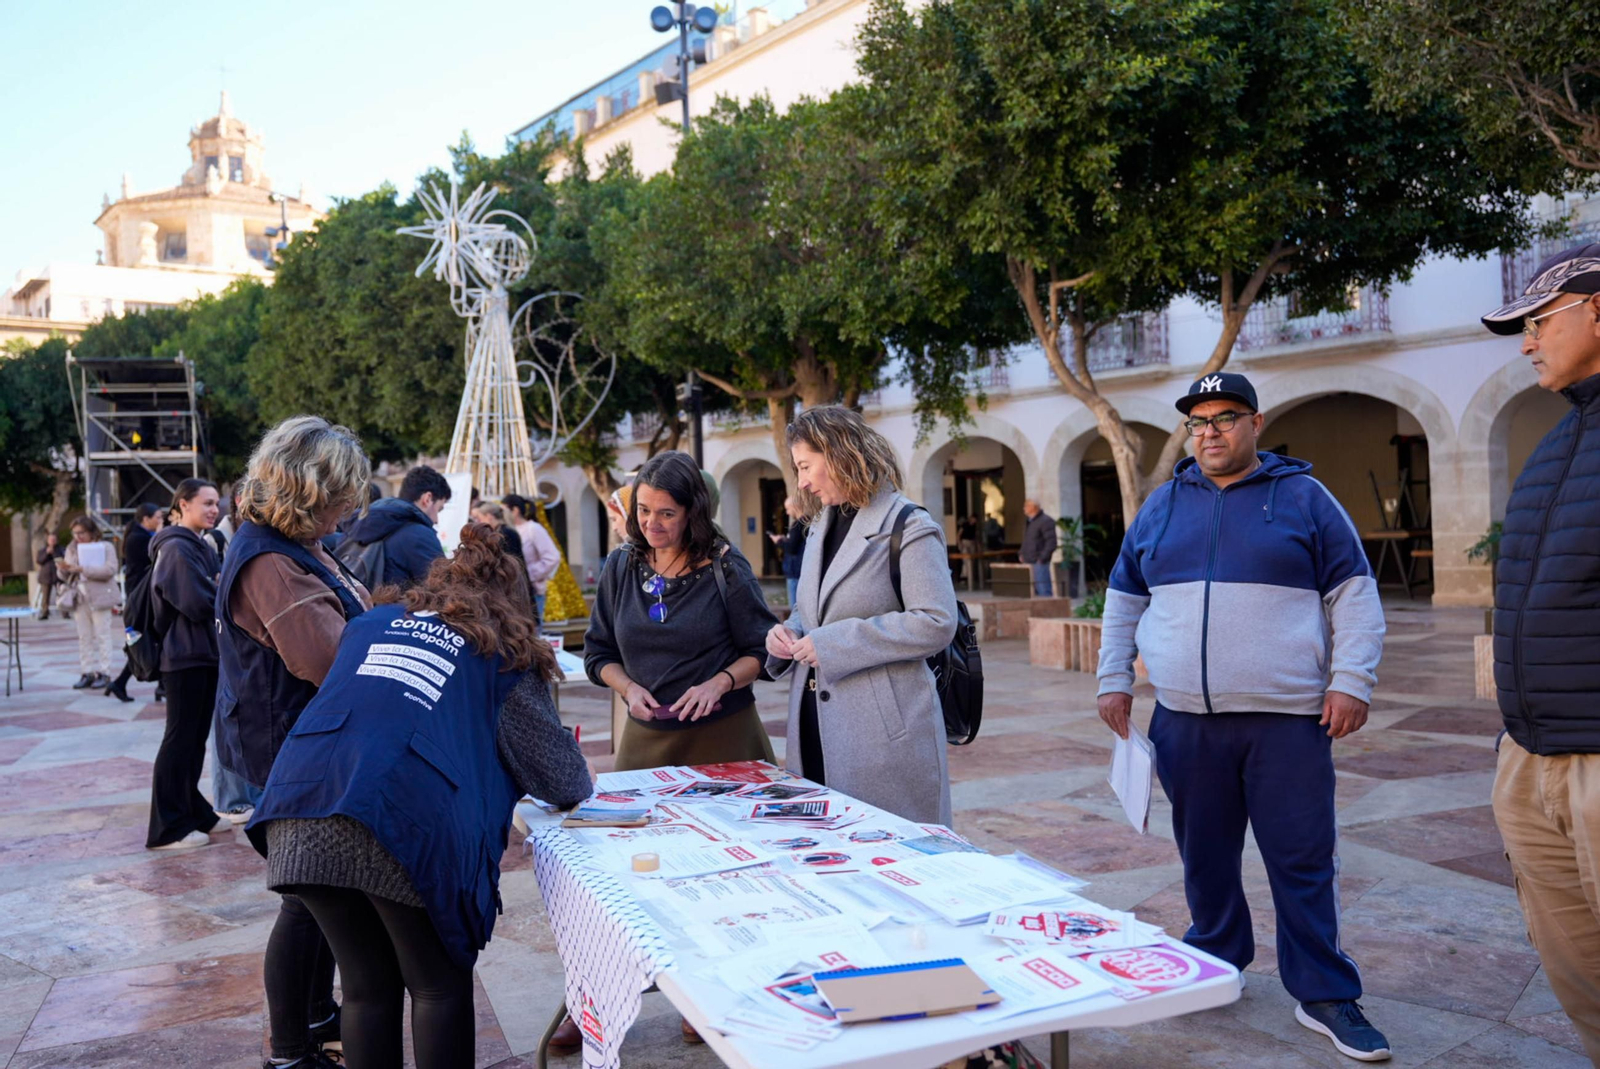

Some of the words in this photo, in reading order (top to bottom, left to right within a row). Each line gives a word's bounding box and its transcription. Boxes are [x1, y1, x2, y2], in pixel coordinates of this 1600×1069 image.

[391, 619, 465, 647] convive
[411, 631, 459, 656] cepaim
[372, 645, 390, 653] Vive
[402, 647, 453, 673] Diversidad
[400, 658, 443, 683] Igualdad
[359, 665, 376, 674] Vive
[377, 667, 387, 675] la
[387, 669, 440, 700] Solidaridad
[403, 691, 432, 710] #convive
[1026, 959, 1077, 988] CCOO
